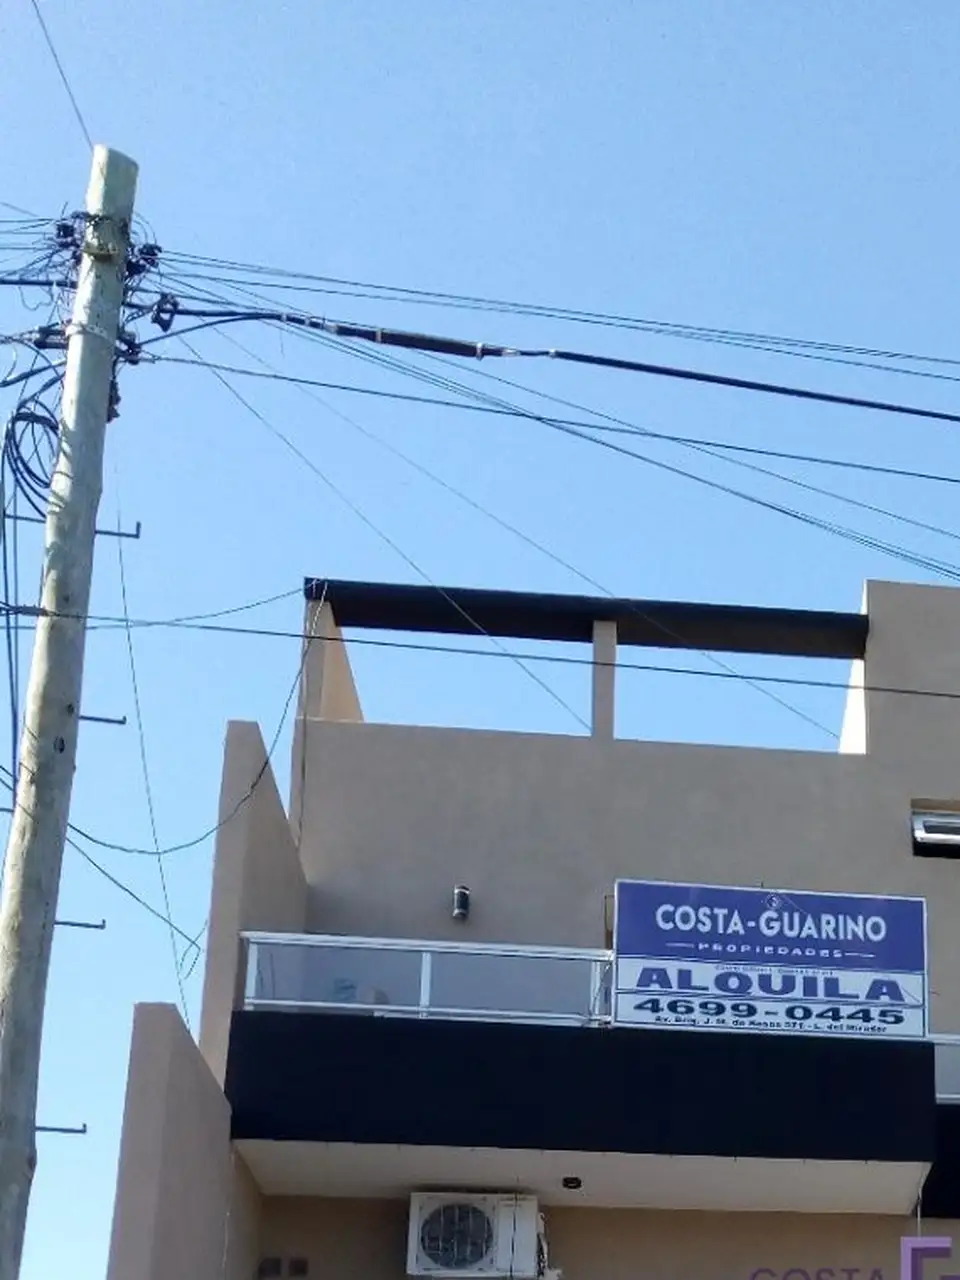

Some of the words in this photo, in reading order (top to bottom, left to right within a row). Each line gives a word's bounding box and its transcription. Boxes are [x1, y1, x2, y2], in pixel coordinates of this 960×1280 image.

[655, 904, 887, 941] COSTA-GUARINO
[698, 943, 842, 957] PROPIEDADES
[636, 967, 905, 1002] ALQUILA
[634, 998, 904, 1025] 4699-0445
